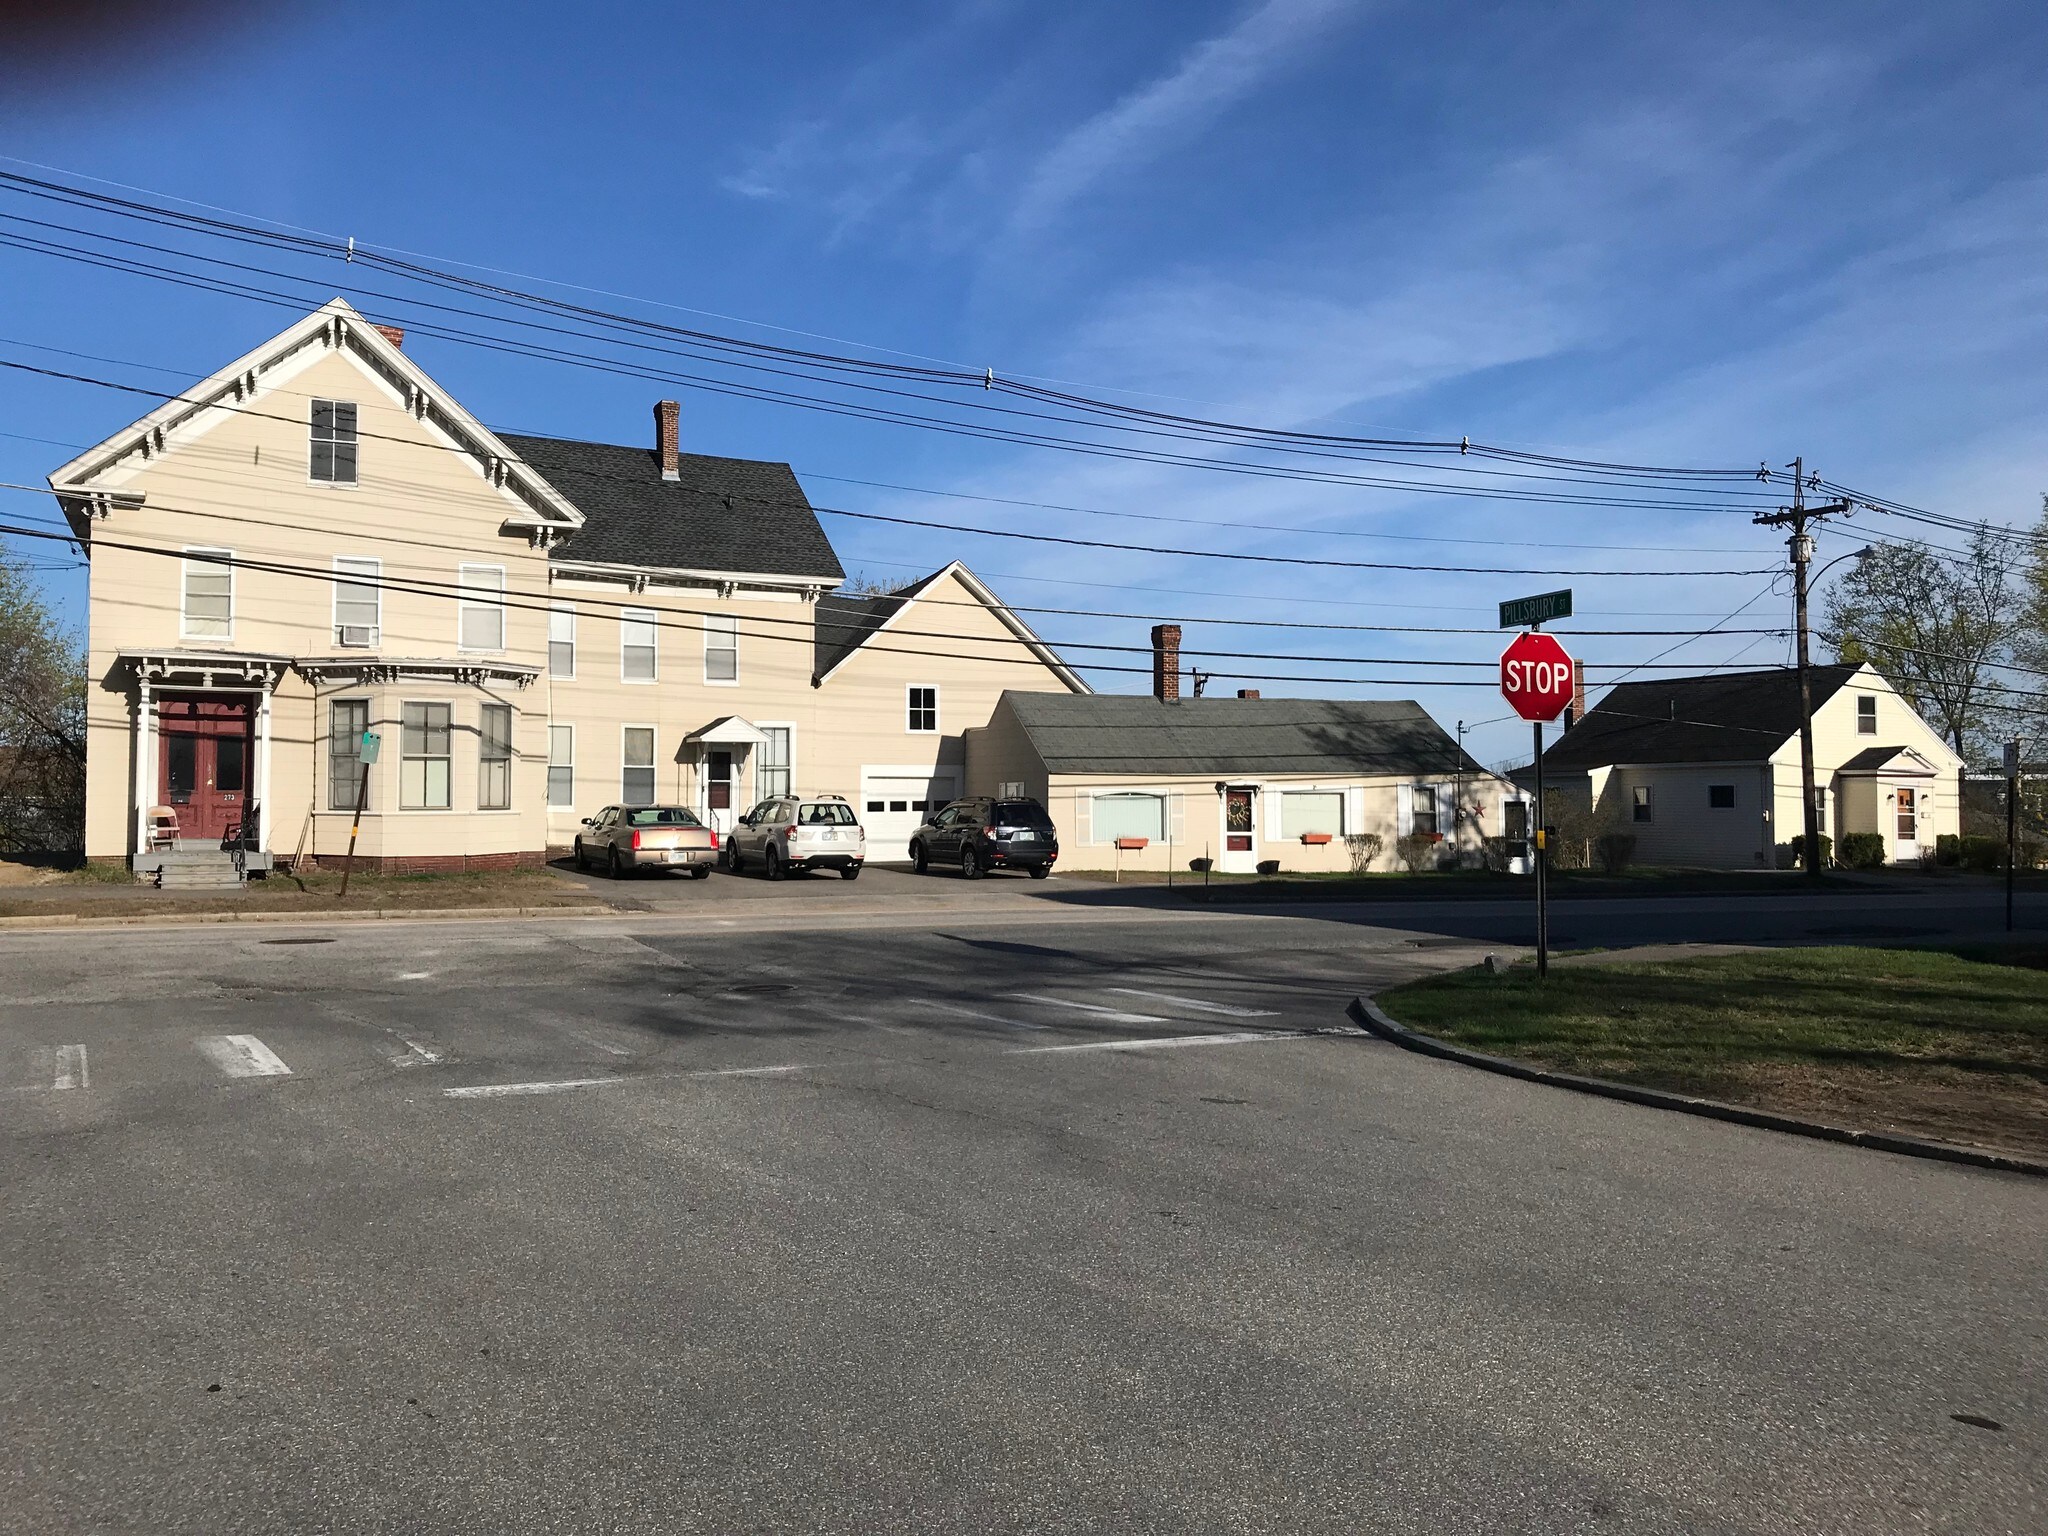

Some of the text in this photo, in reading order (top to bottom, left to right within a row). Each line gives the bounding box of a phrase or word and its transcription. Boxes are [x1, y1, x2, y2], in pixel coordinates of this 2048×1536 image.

[1504, 596, 1566, 624] PILLSBURY ST
[1505, 660, 1569, 694] STOP
